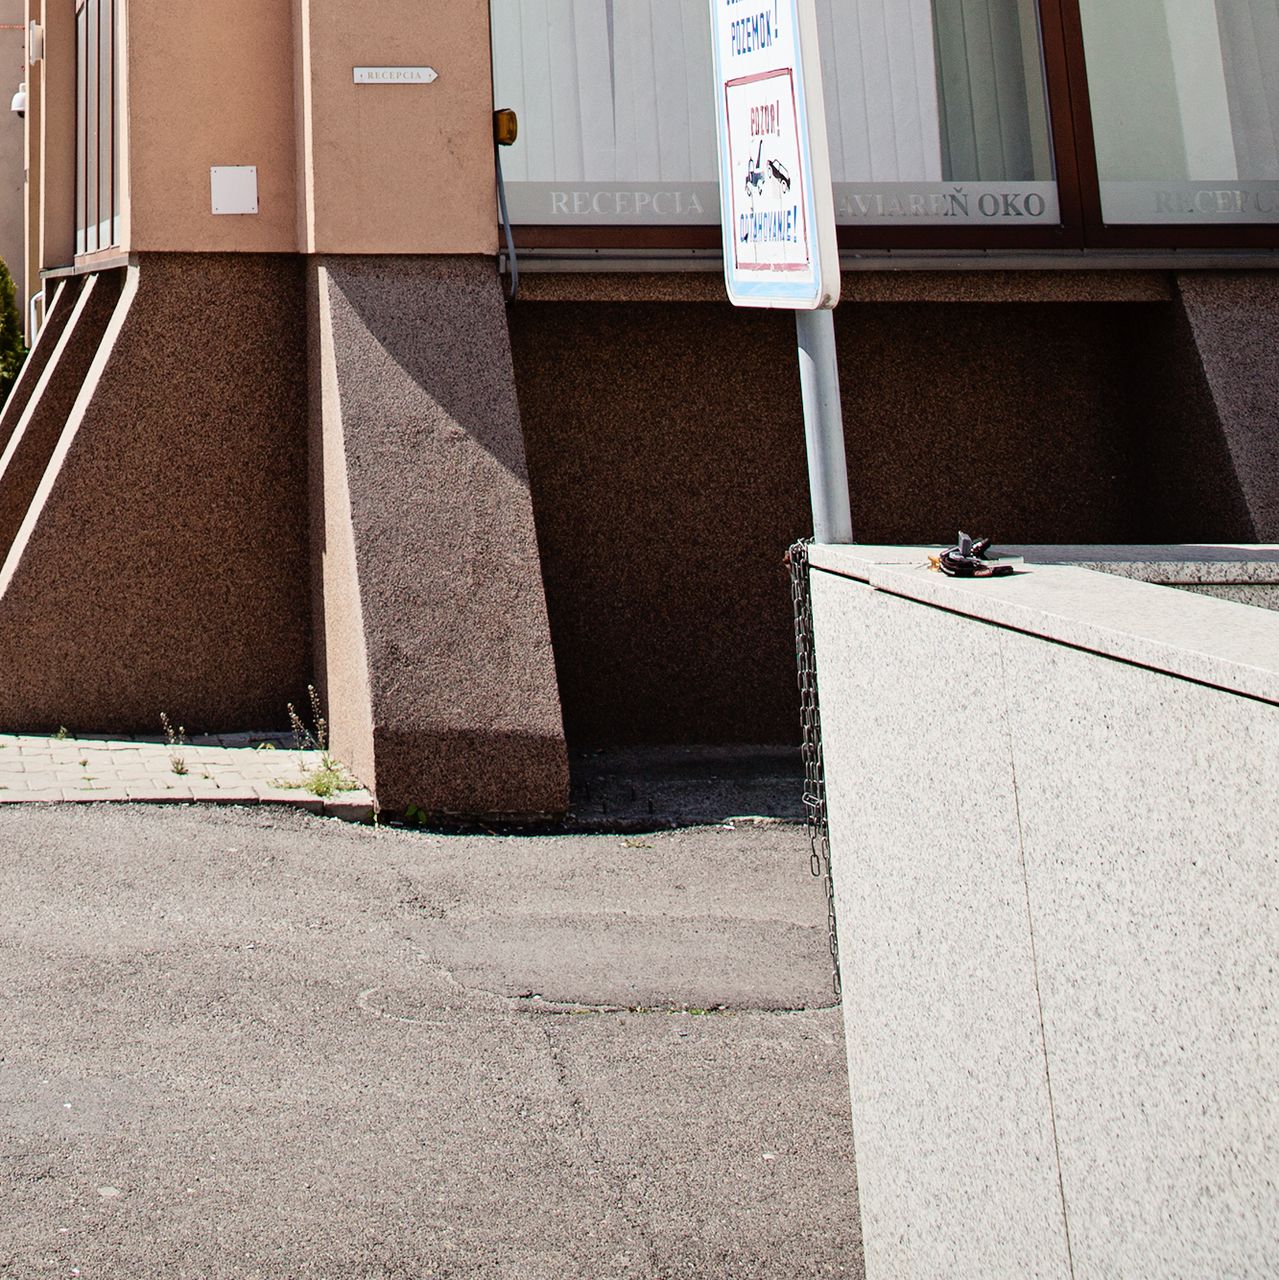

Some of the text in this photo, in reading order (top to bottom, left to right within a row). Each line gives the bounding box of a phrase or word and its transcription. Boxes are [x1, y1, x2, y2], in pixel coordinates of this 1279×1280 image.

[730, 9, 773, 57] POZEMOK
[367, 71, 422, 80] RECEPCIA
[550, 191, 705, 215] RECEPCIA
[837, 186, 1046, 218] AVIAREŇ OKO
